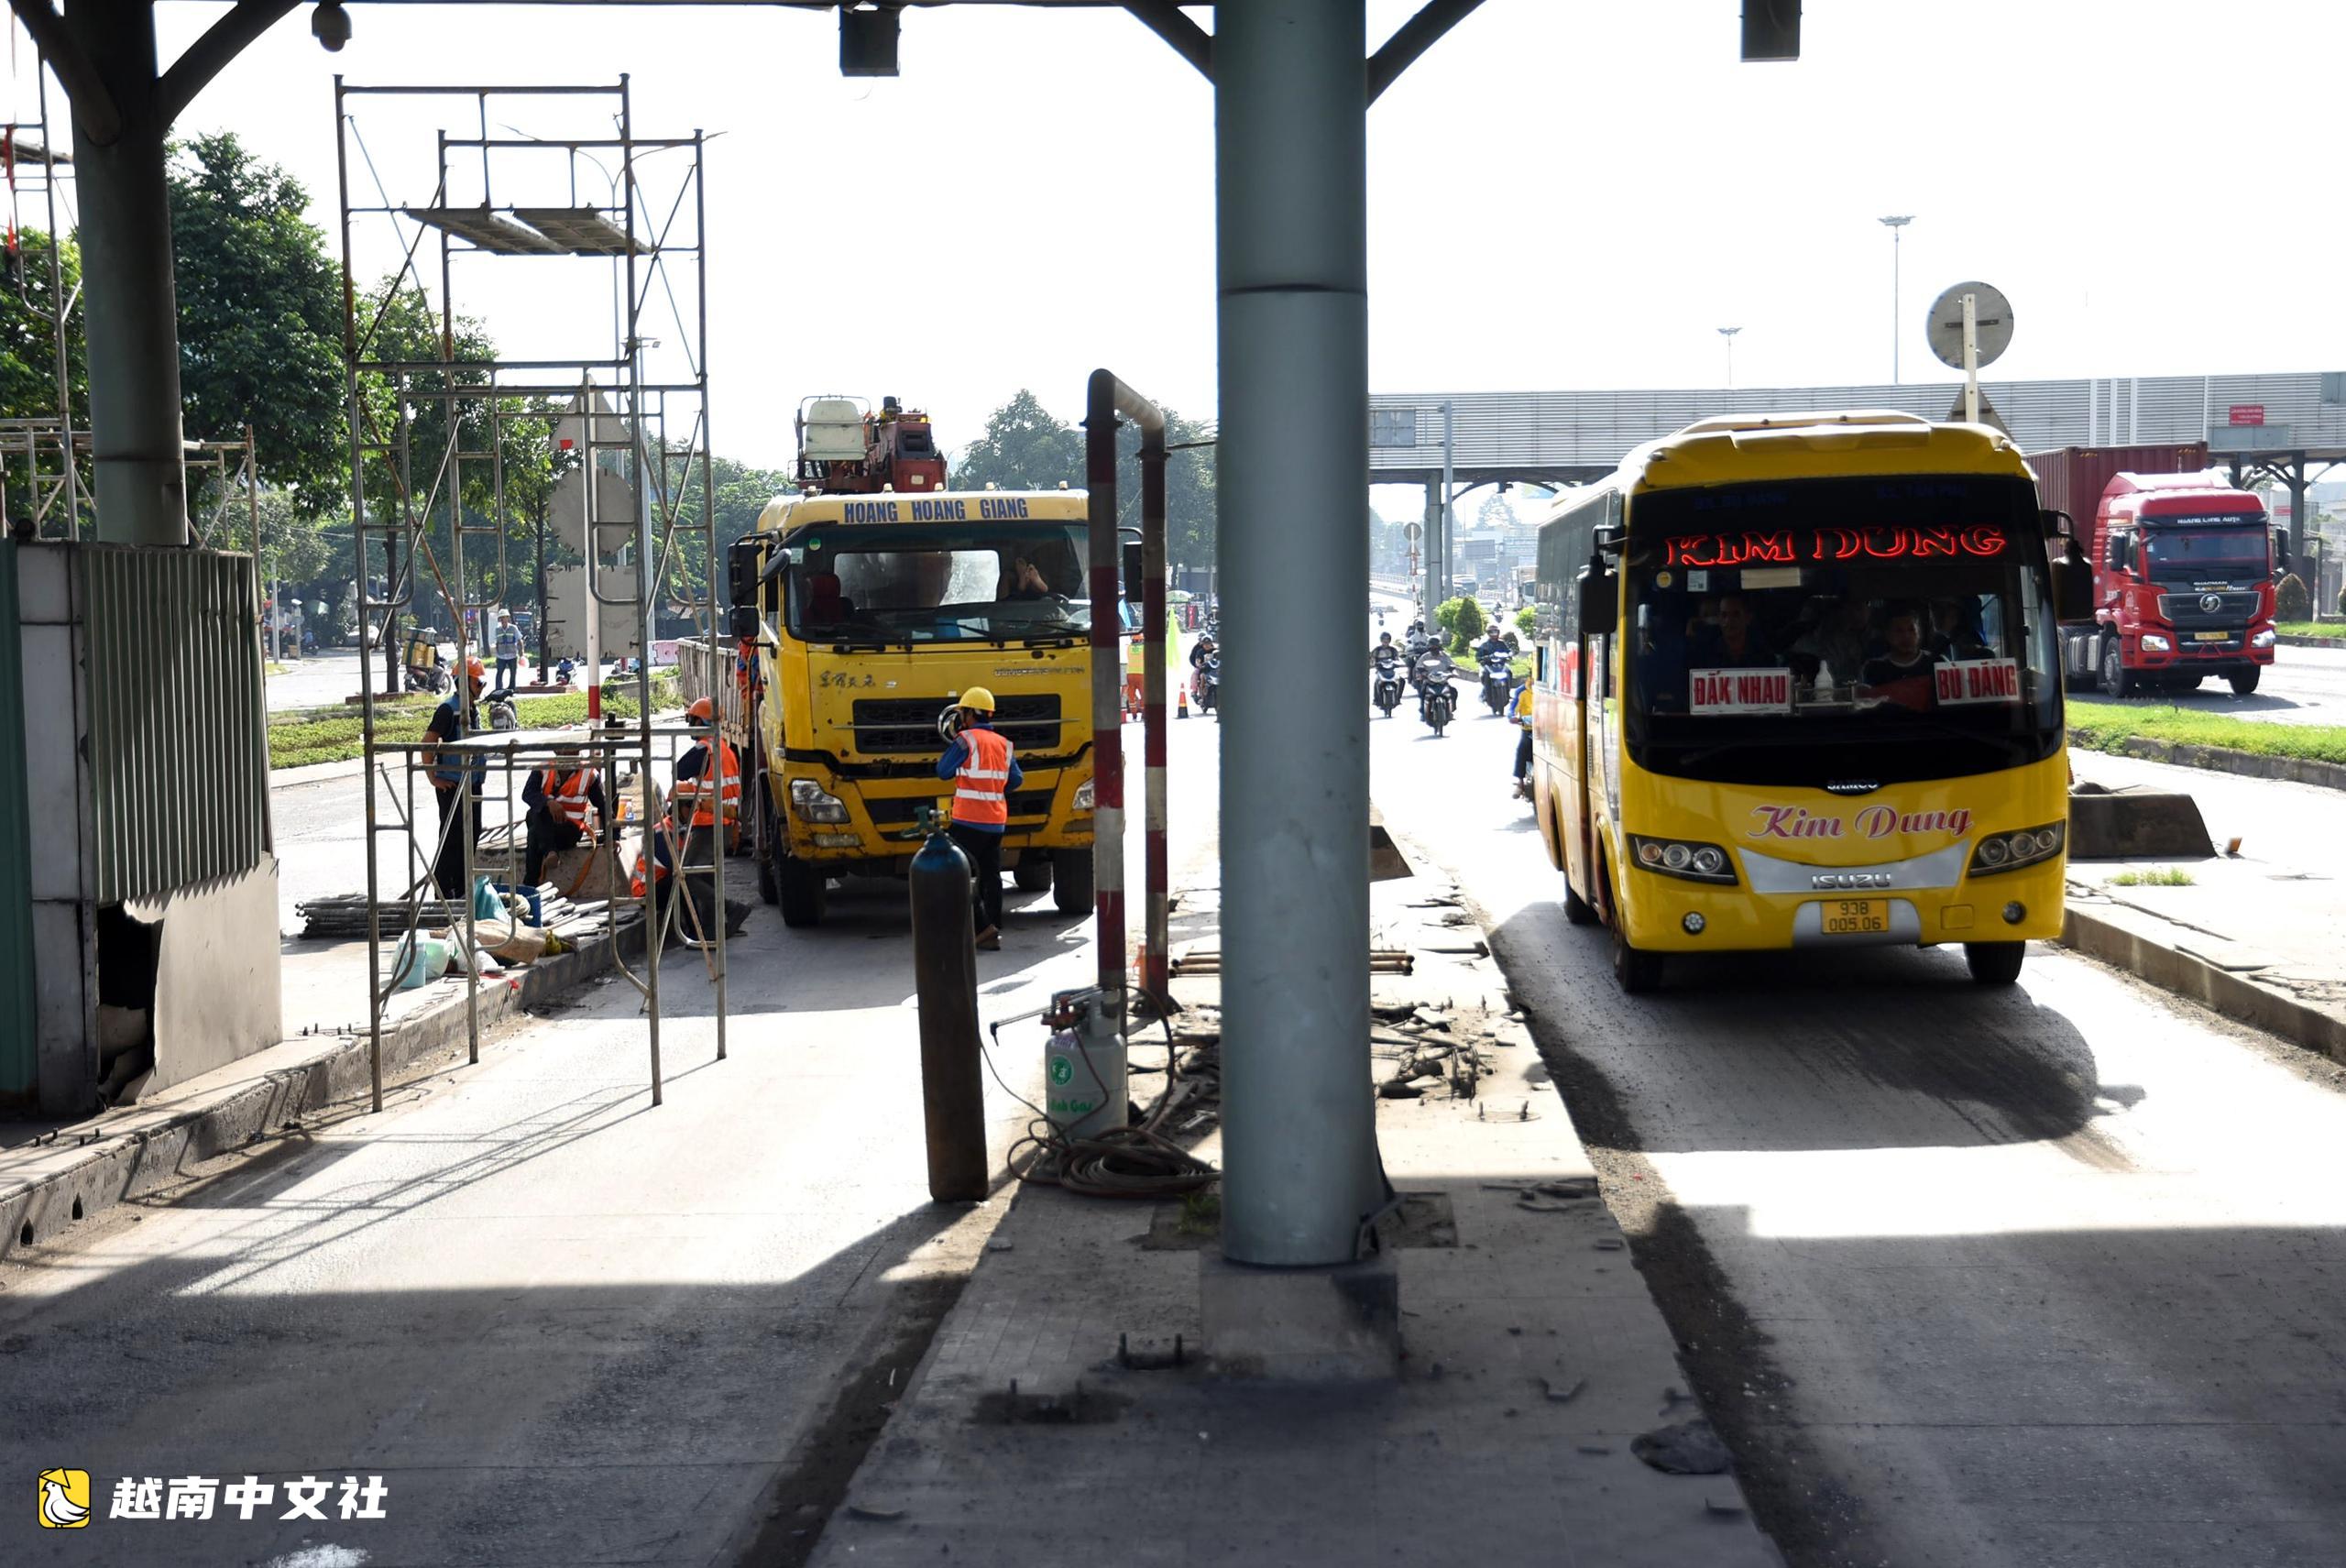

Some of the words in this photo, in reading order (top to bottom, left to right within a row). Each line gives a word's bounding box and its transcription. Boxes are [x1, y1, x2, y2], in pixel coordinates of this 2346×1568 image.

[844, 501, 898, 523] HOANG
[911, 499, 966, 521] HOANG
[980, 498, 1028, 519] GIANG
[1664, 532, 1796, 565] KIM
[1812, 525, 2007, 558] DUNG
[1737, 674, 1786, 705] NHAU
[1748, 806, 1846, 839] Kim
[1855, 806, 1974, 839] Dung
[1812, 873, 1891, 889] ISUZU
[1839, 901, 1869, 916] 93B
[1829, 916, 1881, 931] 005.06
